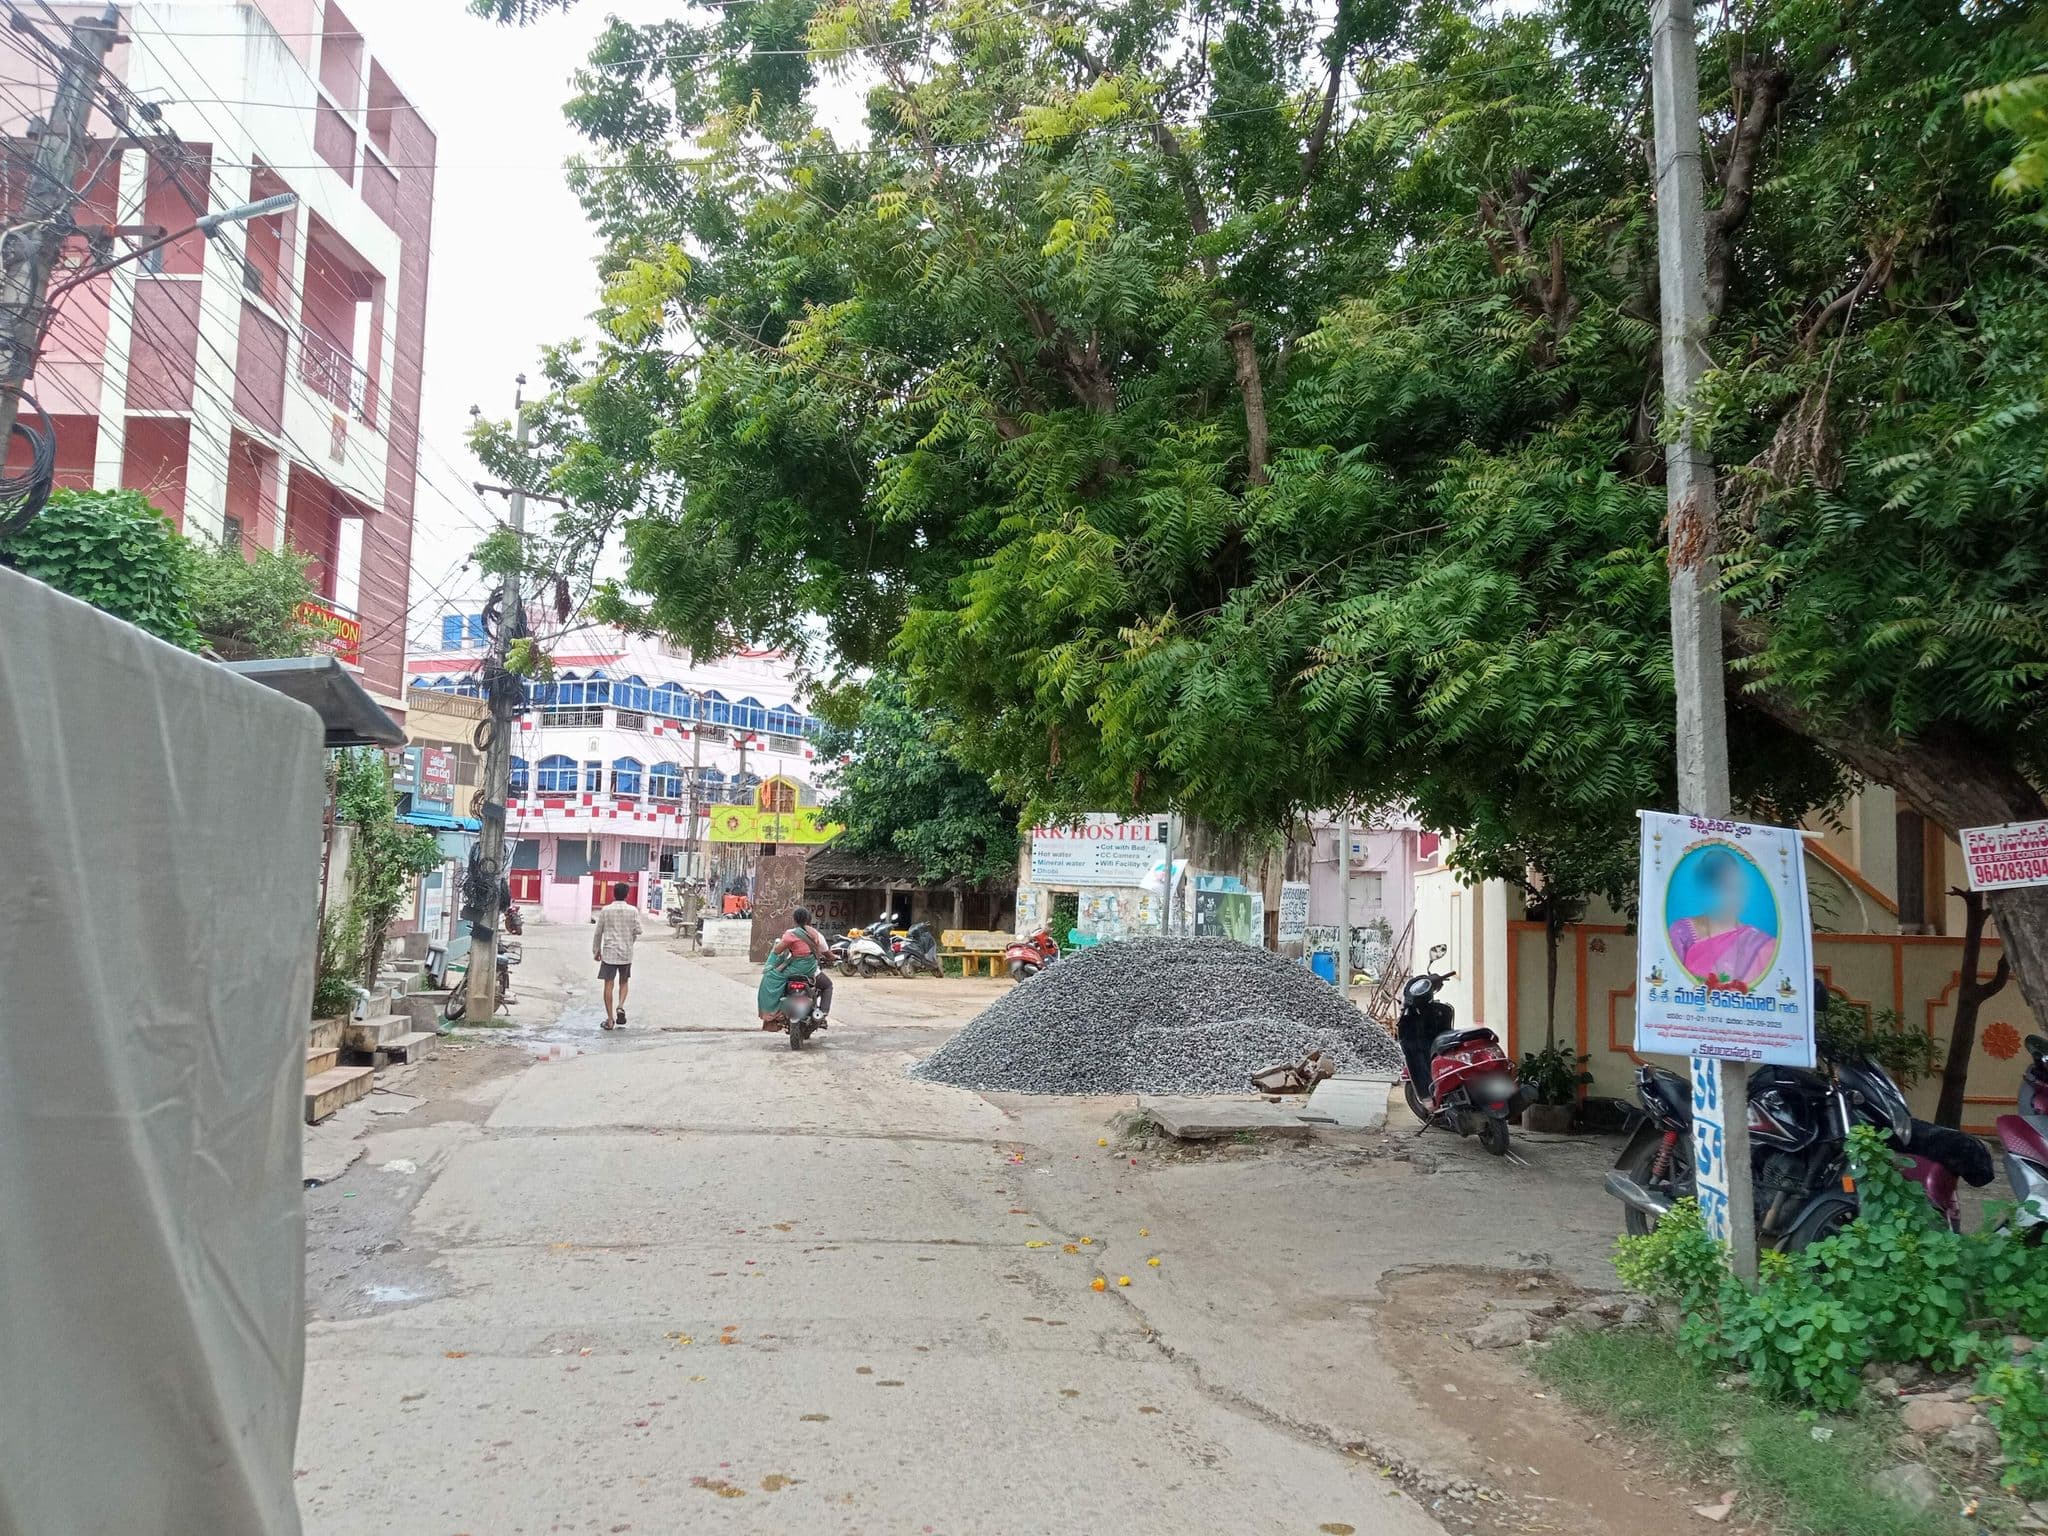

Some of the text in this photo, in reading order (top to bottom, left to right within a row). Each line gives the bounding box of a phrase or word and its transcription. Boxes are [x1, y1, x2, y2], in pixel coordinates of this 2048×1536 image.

[303, 604, 359, 643] MNSION
[1070, 824, 1157, 840] HOSTEL
[1115, 860, 1141, 868] Facility
[1994, 853, 2015, 862] PEST
[1710, 991, 1776, 1012] శివకుమారి
[1779, 1002, 1799, 1014] గారు
